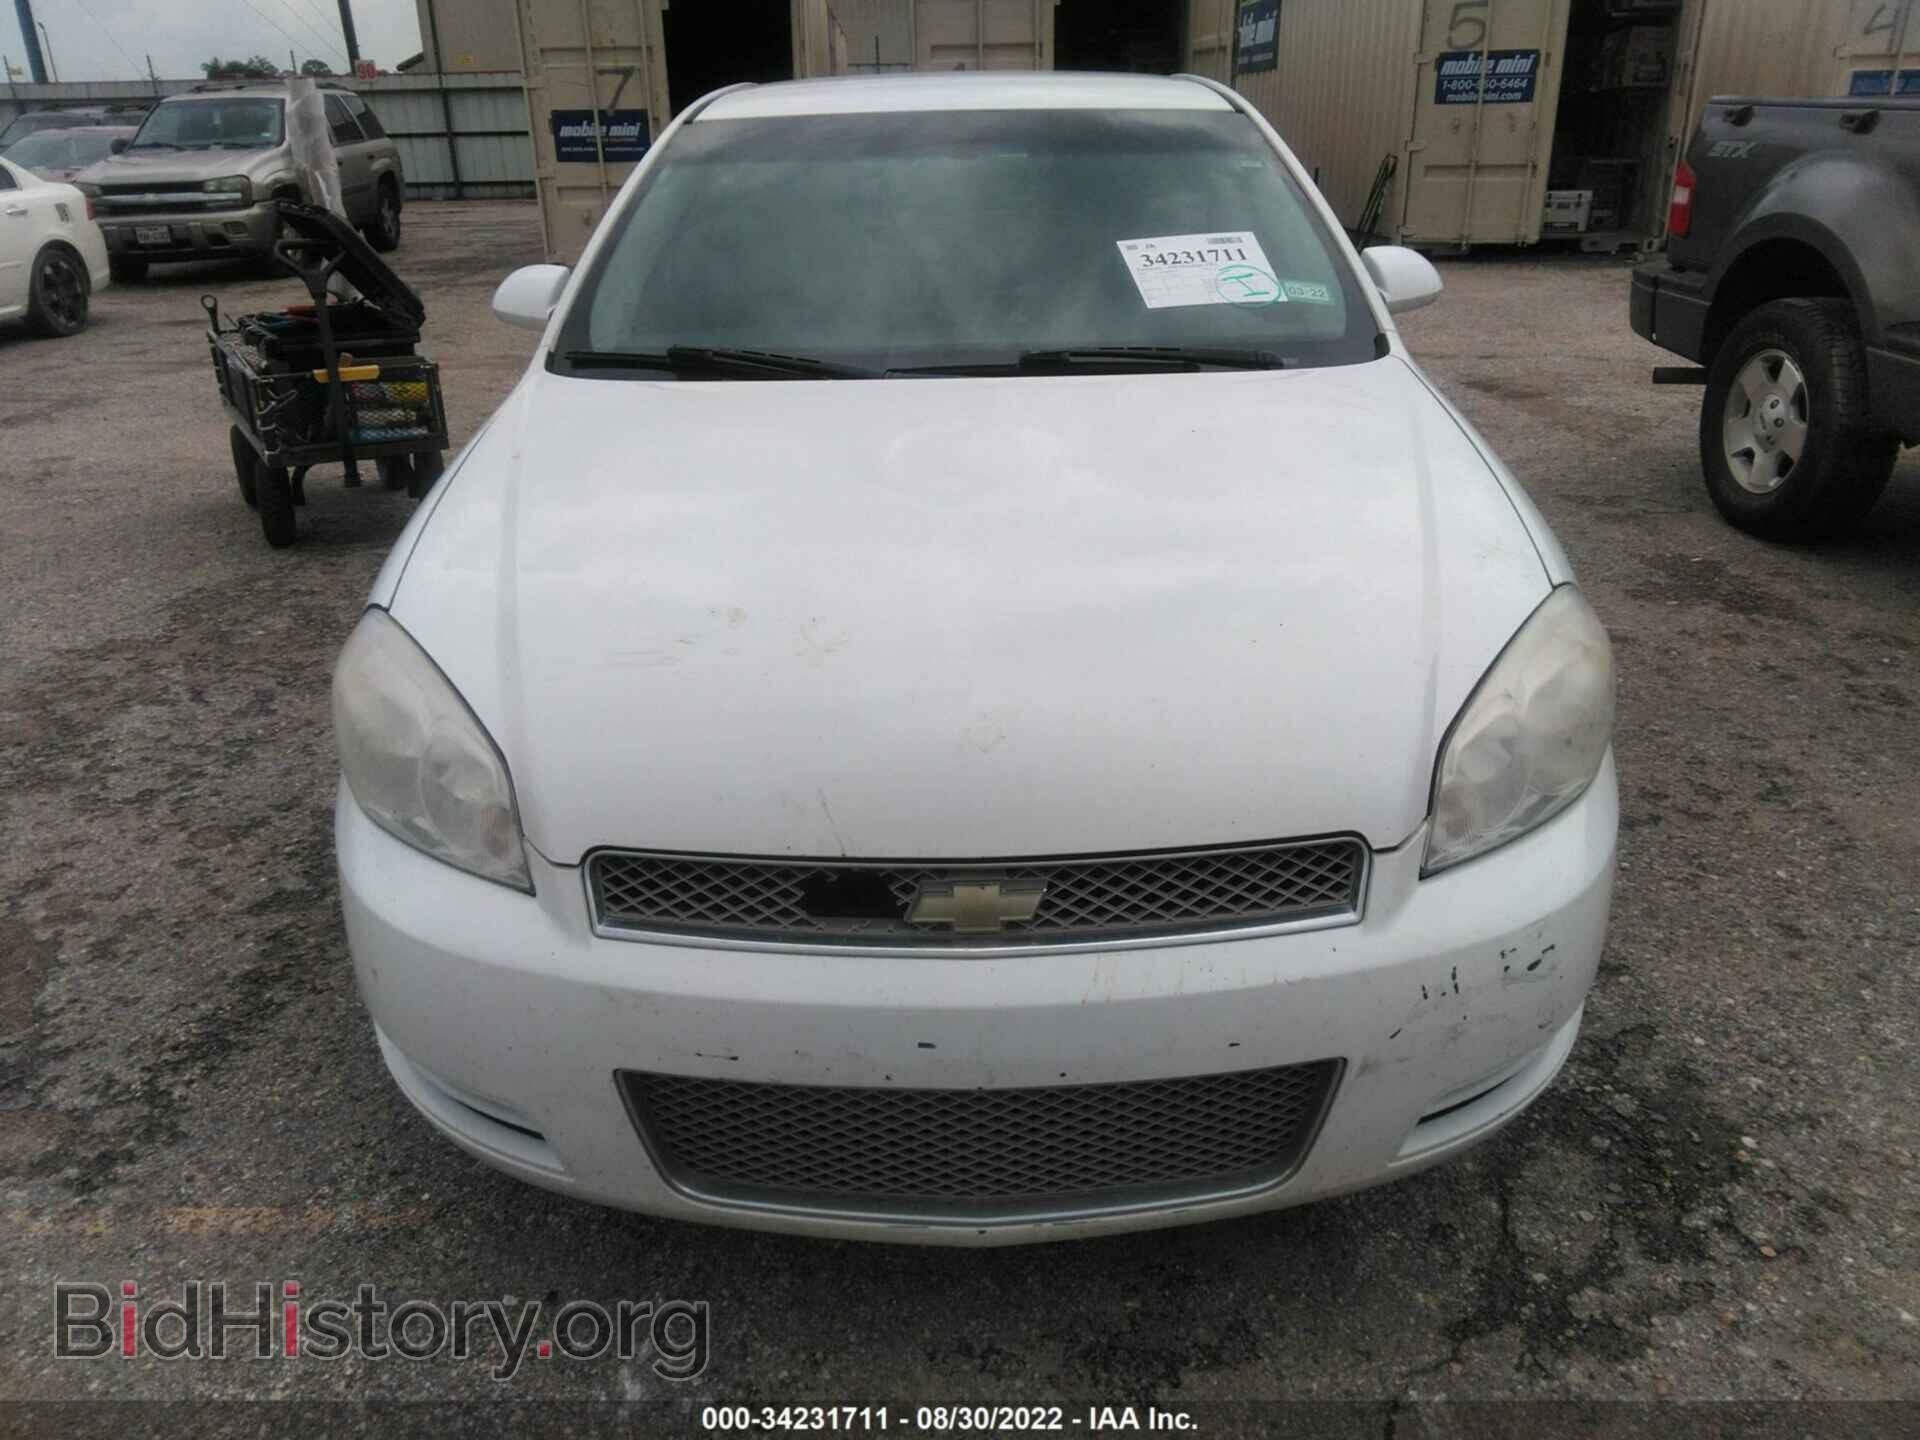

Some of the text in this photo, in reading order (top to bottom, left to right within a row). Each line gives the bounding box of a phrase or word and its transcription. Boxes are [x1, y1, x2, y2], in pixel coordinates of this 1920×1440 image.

[1446, 1, 1487, 49] 5
[1440, 53, 1536, 75] mobie mini
[596, 66, 635, 113] 7
[560, 121, 641, 137] mobie mini
[1140, 248, 1247, 268] 34231711
